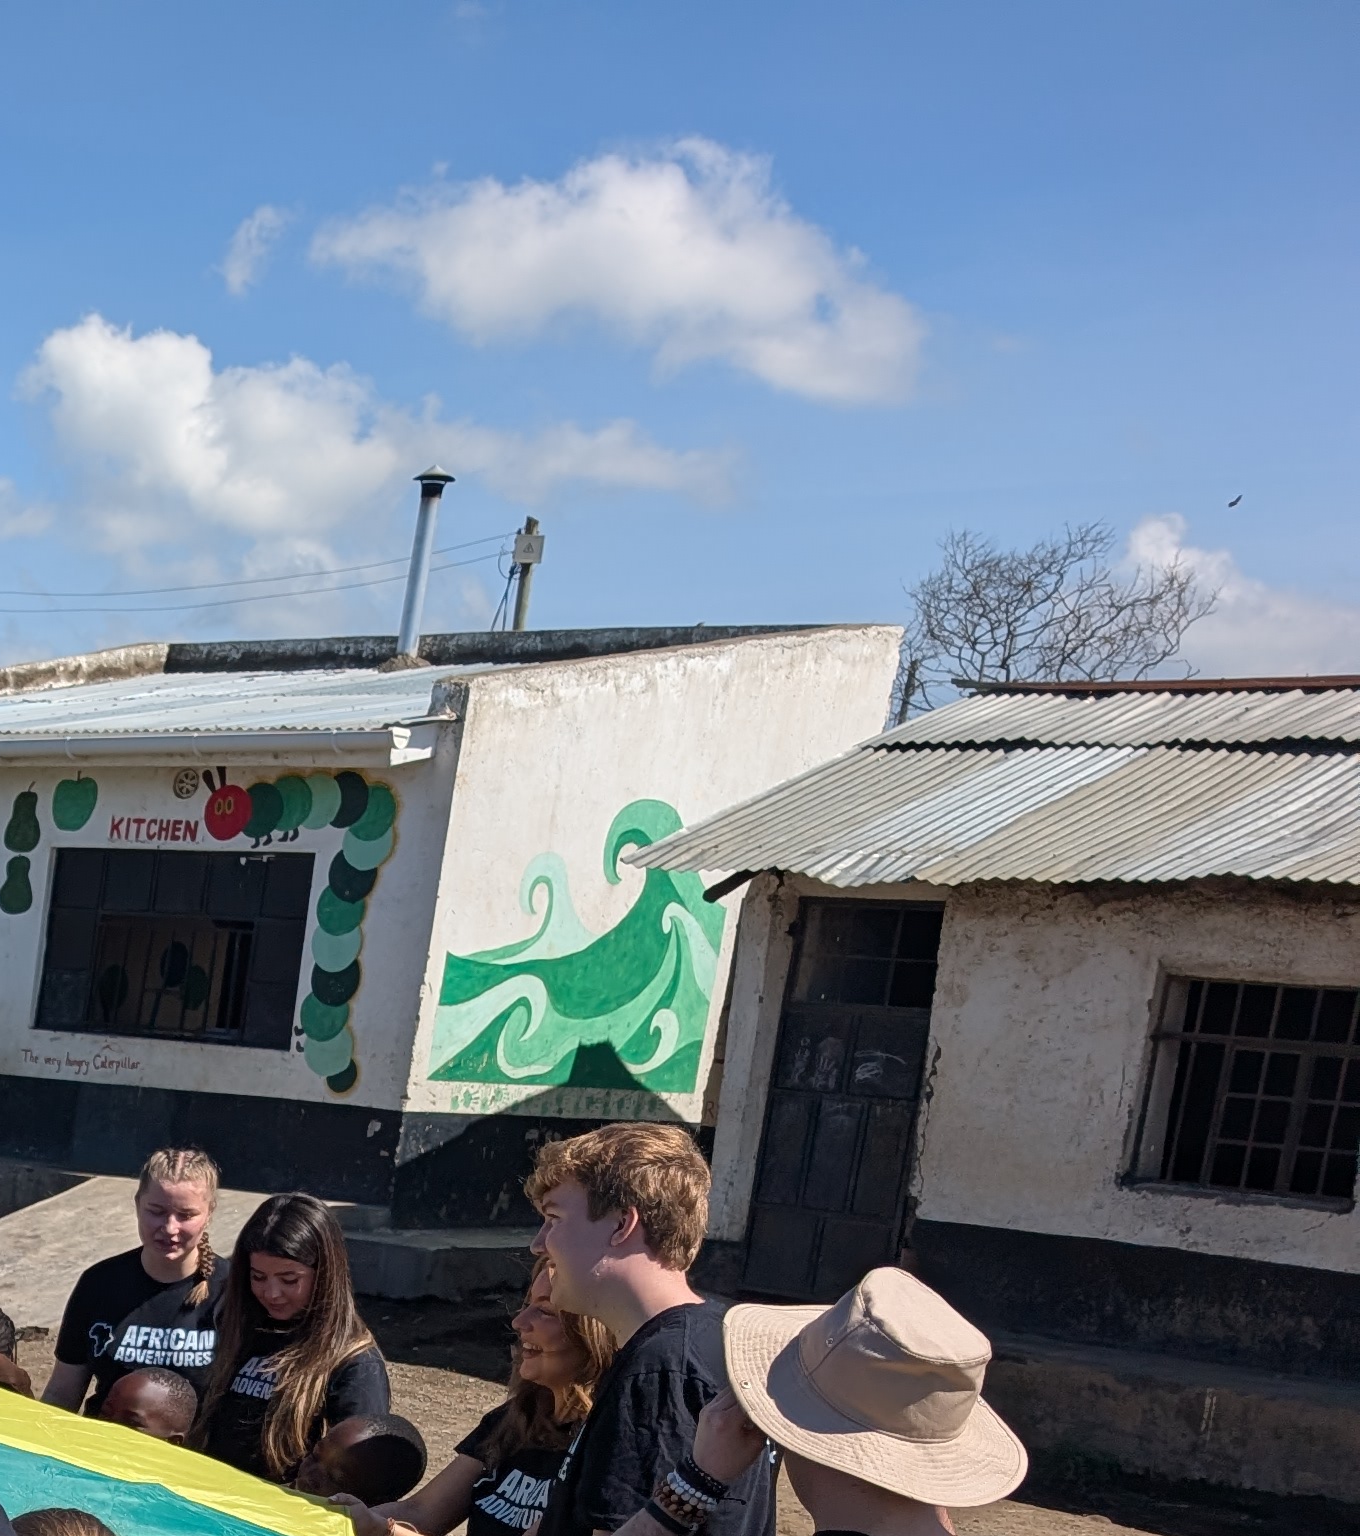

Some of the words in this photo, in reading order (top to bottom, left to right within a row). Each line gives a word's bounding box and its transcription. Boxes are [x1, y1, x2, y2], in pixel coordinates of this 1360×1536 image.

[109, 815, 199, 842] KITCHEN
[21, 1048, 39, 1064] The
[44, 1056, 62, 1073] very
[93, 1054, 140, 1075] Caterpillar
[121, 1325, 216, 1350] AFRICAN
[114, 1347, 212, 1368] ADVENTURES
